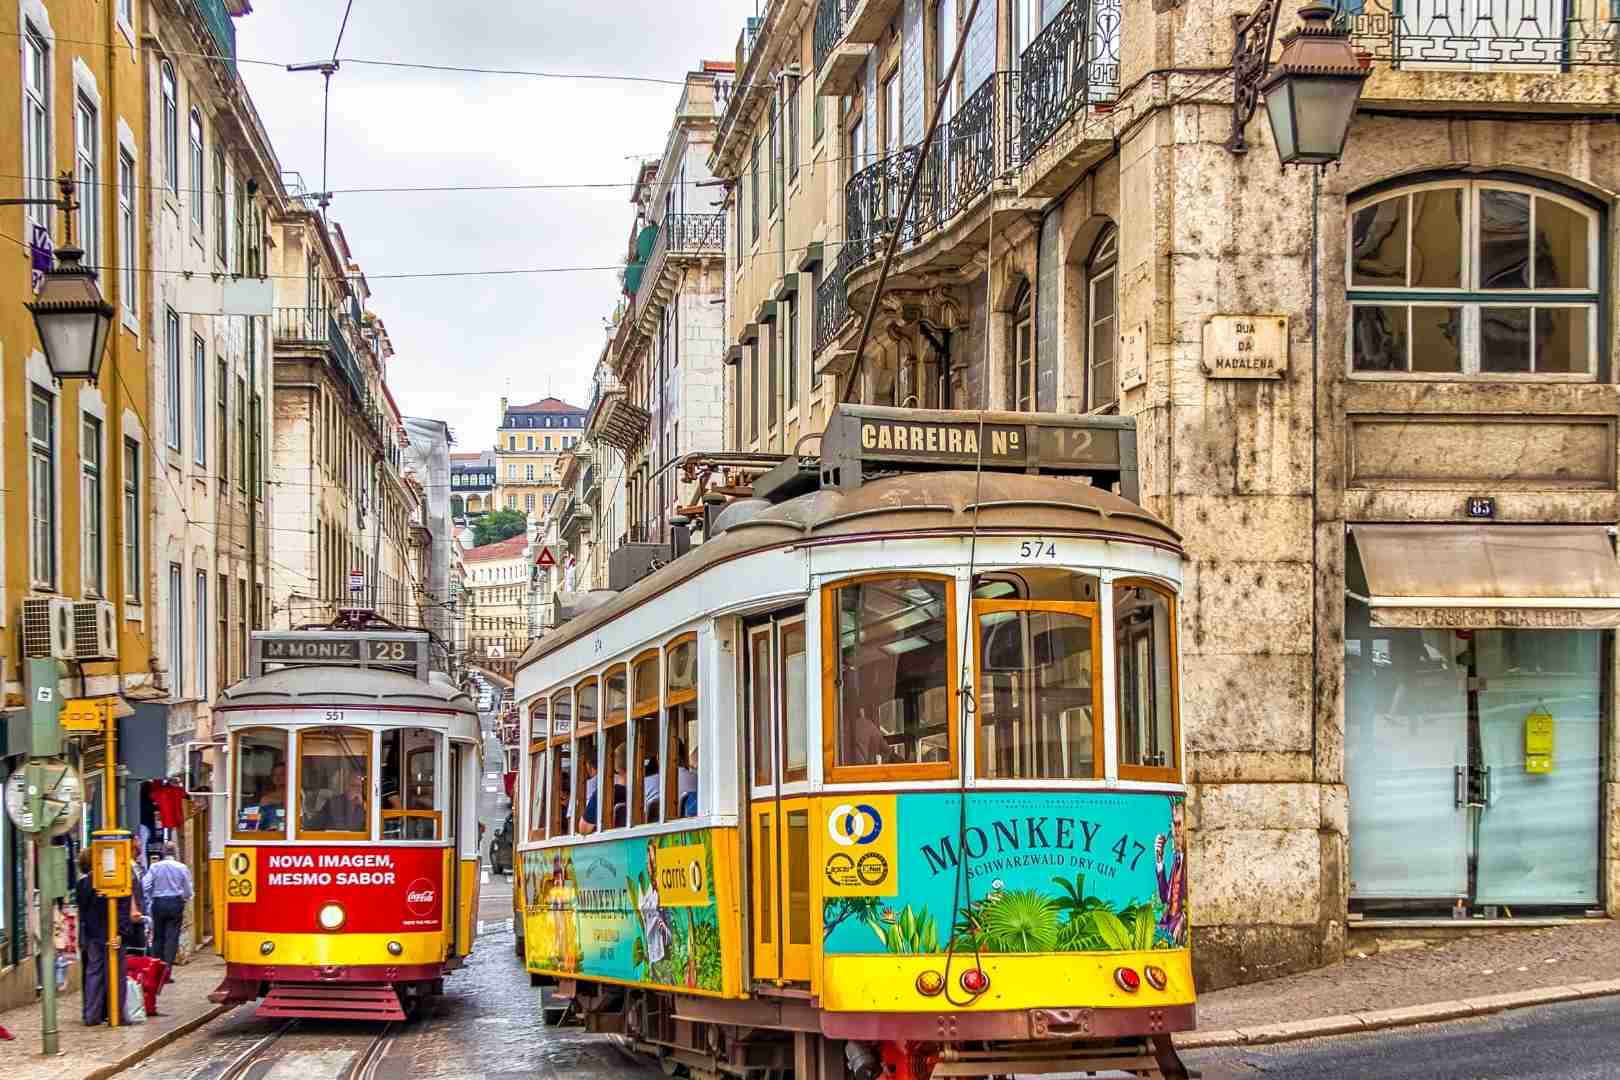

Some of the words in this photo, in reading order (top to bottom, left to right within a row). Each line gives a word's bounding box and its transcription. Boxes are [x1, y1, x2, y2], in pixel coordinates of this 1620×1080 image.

[1238, 341, 1252, 352] DA
[1215, 357, 1274, 369] MADALENA
[861, 424, 978, 453] CARREIRA
[1053, 430, 1095, 459] 12
[1020, 541, 1057, 558] 574
[376, 642, 406, 660] 28
[325, 711, 345, 721] 551
[919, 816, 1102, 877] MONKEY
[1110, 834, 1147, 872] 47
[269, 855, 315, 868] NOVA
[318, 855, 395, 869] IMAGEM,
[967, 854, 1065, 881] SCHWARZWALD
[1069, 856, 1095, 871] DRY
[1097, 863, 1117, 879] GIN
[268, 873, 332, 886] MESMO
[335, 873, 396, 885] SABOR
